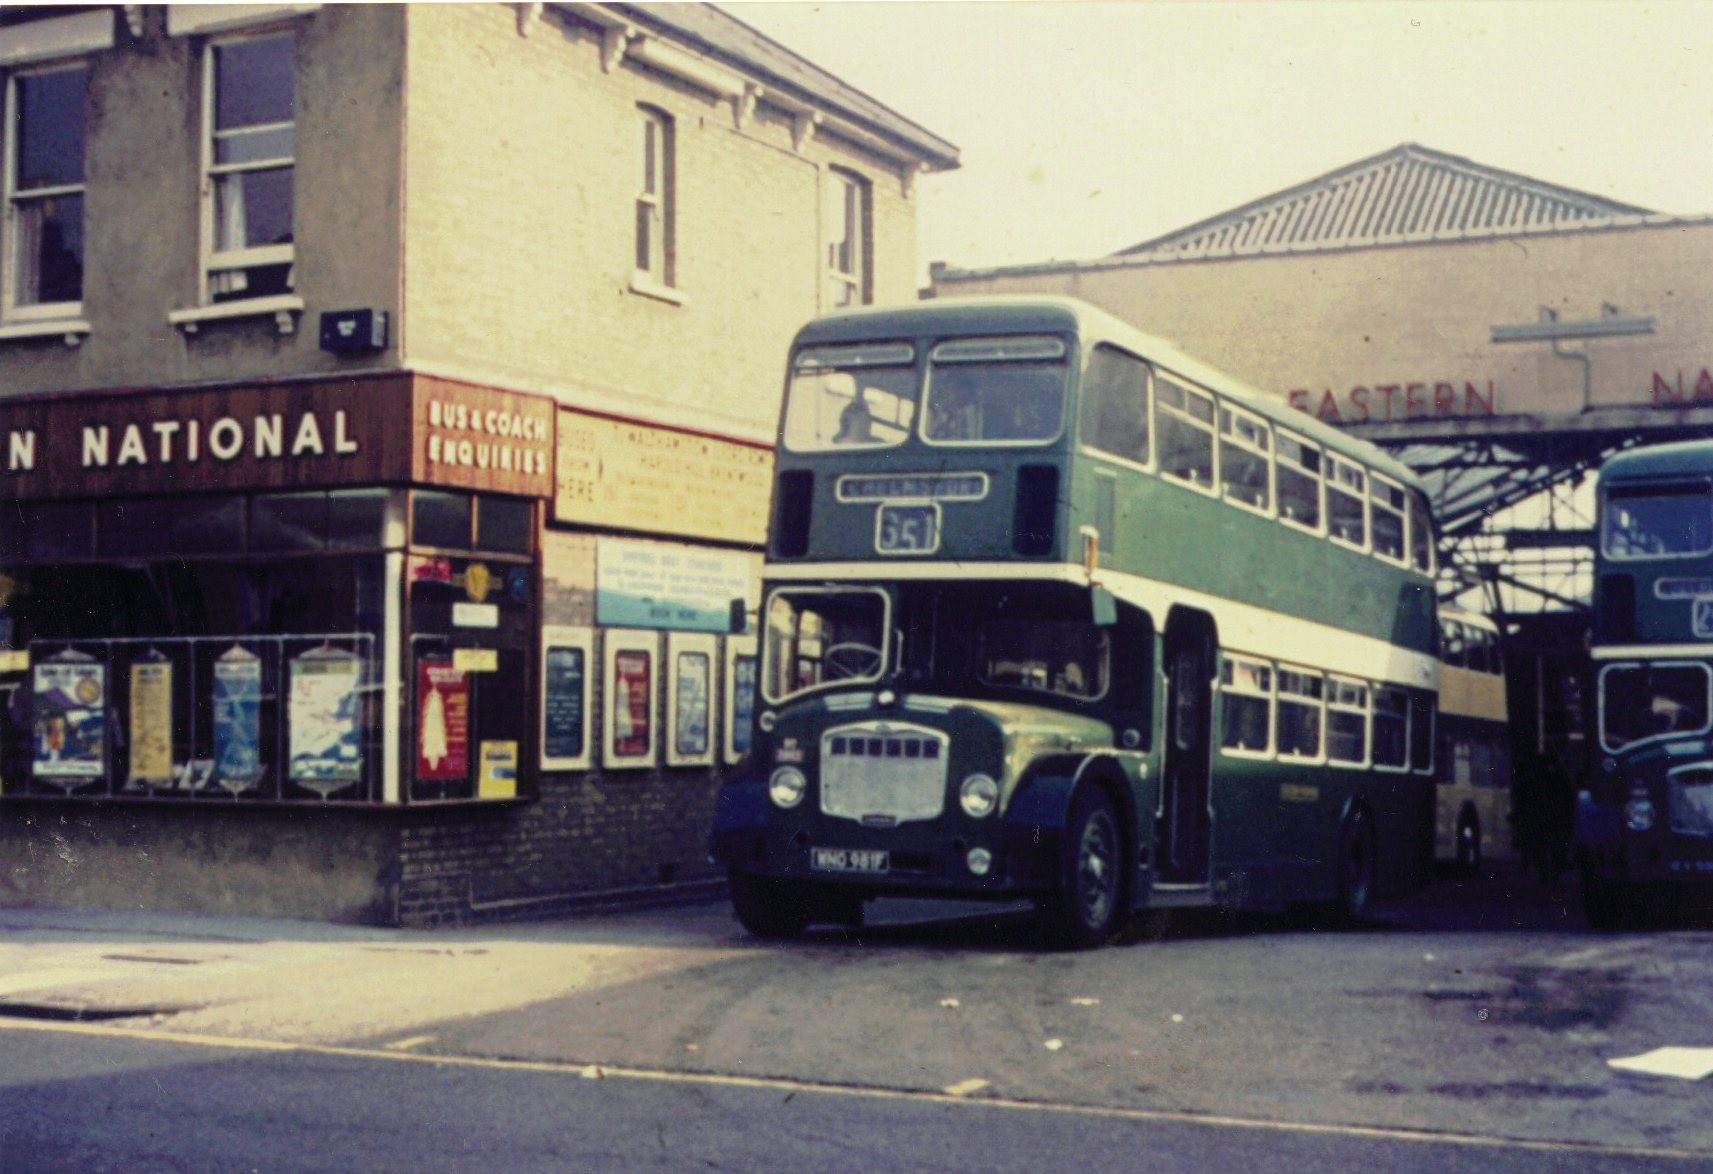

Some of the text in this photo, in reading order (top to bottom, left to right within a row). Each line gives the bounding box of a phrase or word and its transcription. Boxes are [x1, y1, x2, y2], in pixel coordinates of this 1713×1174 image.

[1289, 379, 1495, 424] EASTERN
[82, 410, 358, 467] NATIONAL
[428, 434, 546, 474] ENQUIRIES
